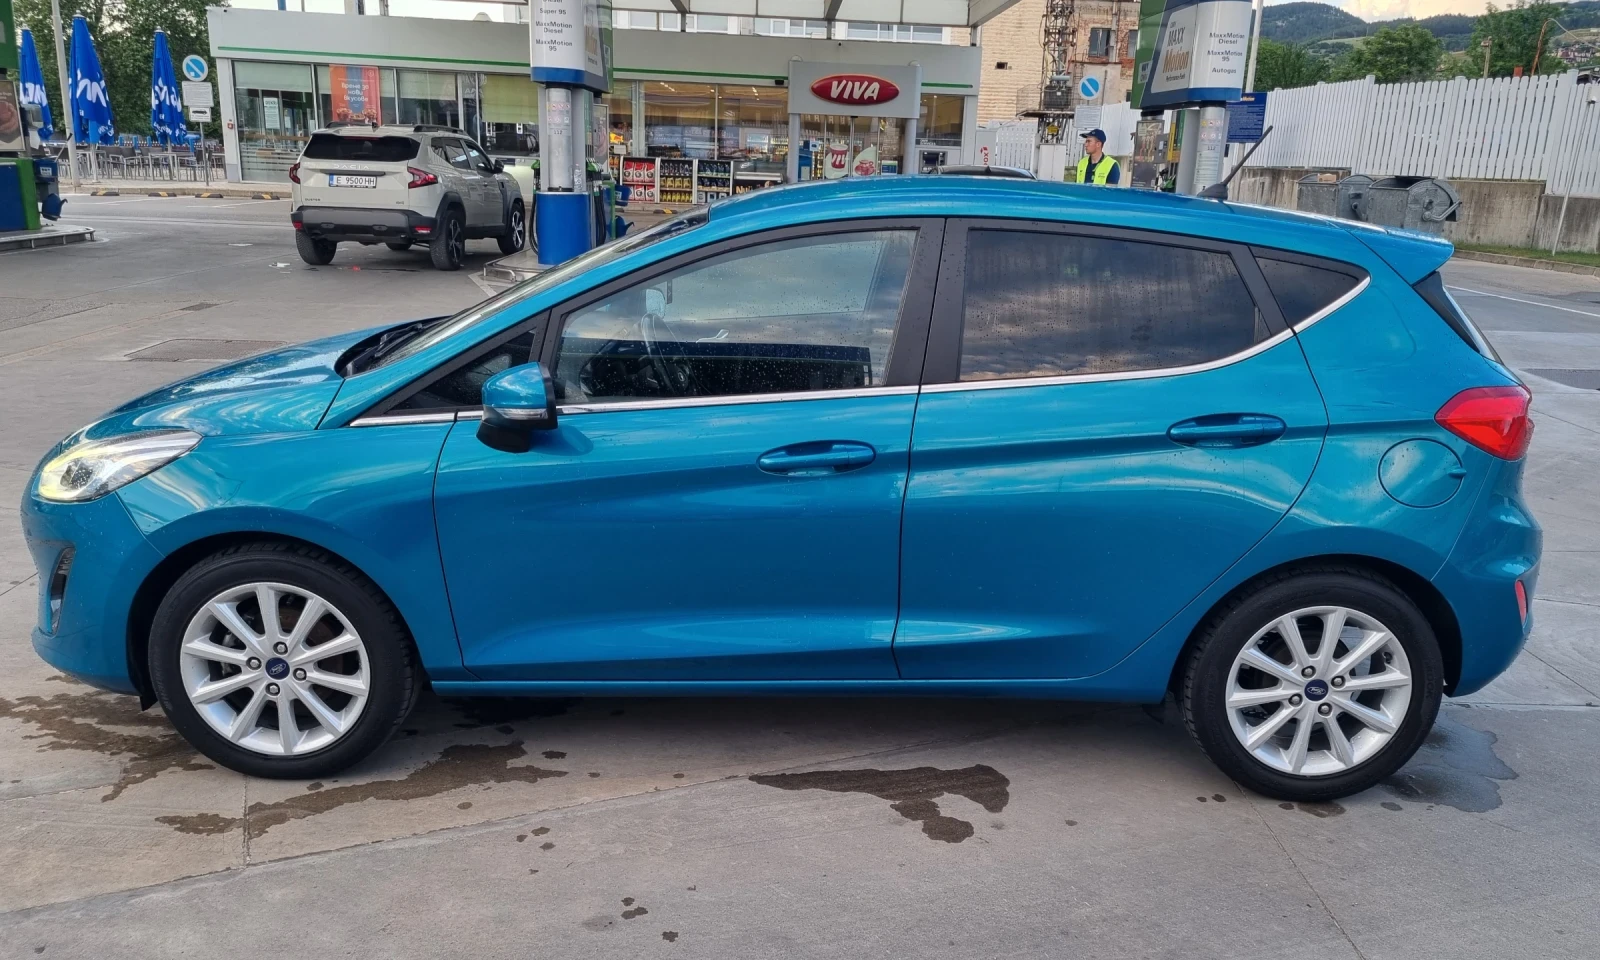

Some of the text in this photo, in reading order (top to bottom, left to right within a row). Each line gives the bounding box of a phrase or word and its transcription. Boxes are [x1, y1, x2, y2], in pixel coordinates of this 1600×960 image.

[536, 21, 573, 29] MaxxMotion
[1167, 26, 1185, 47] MAXX
[1162, 46, 1190, 74] Motion
[830, 79, 880, 100] VIVA
[336, 176, 375, 186] E 9500 HH
